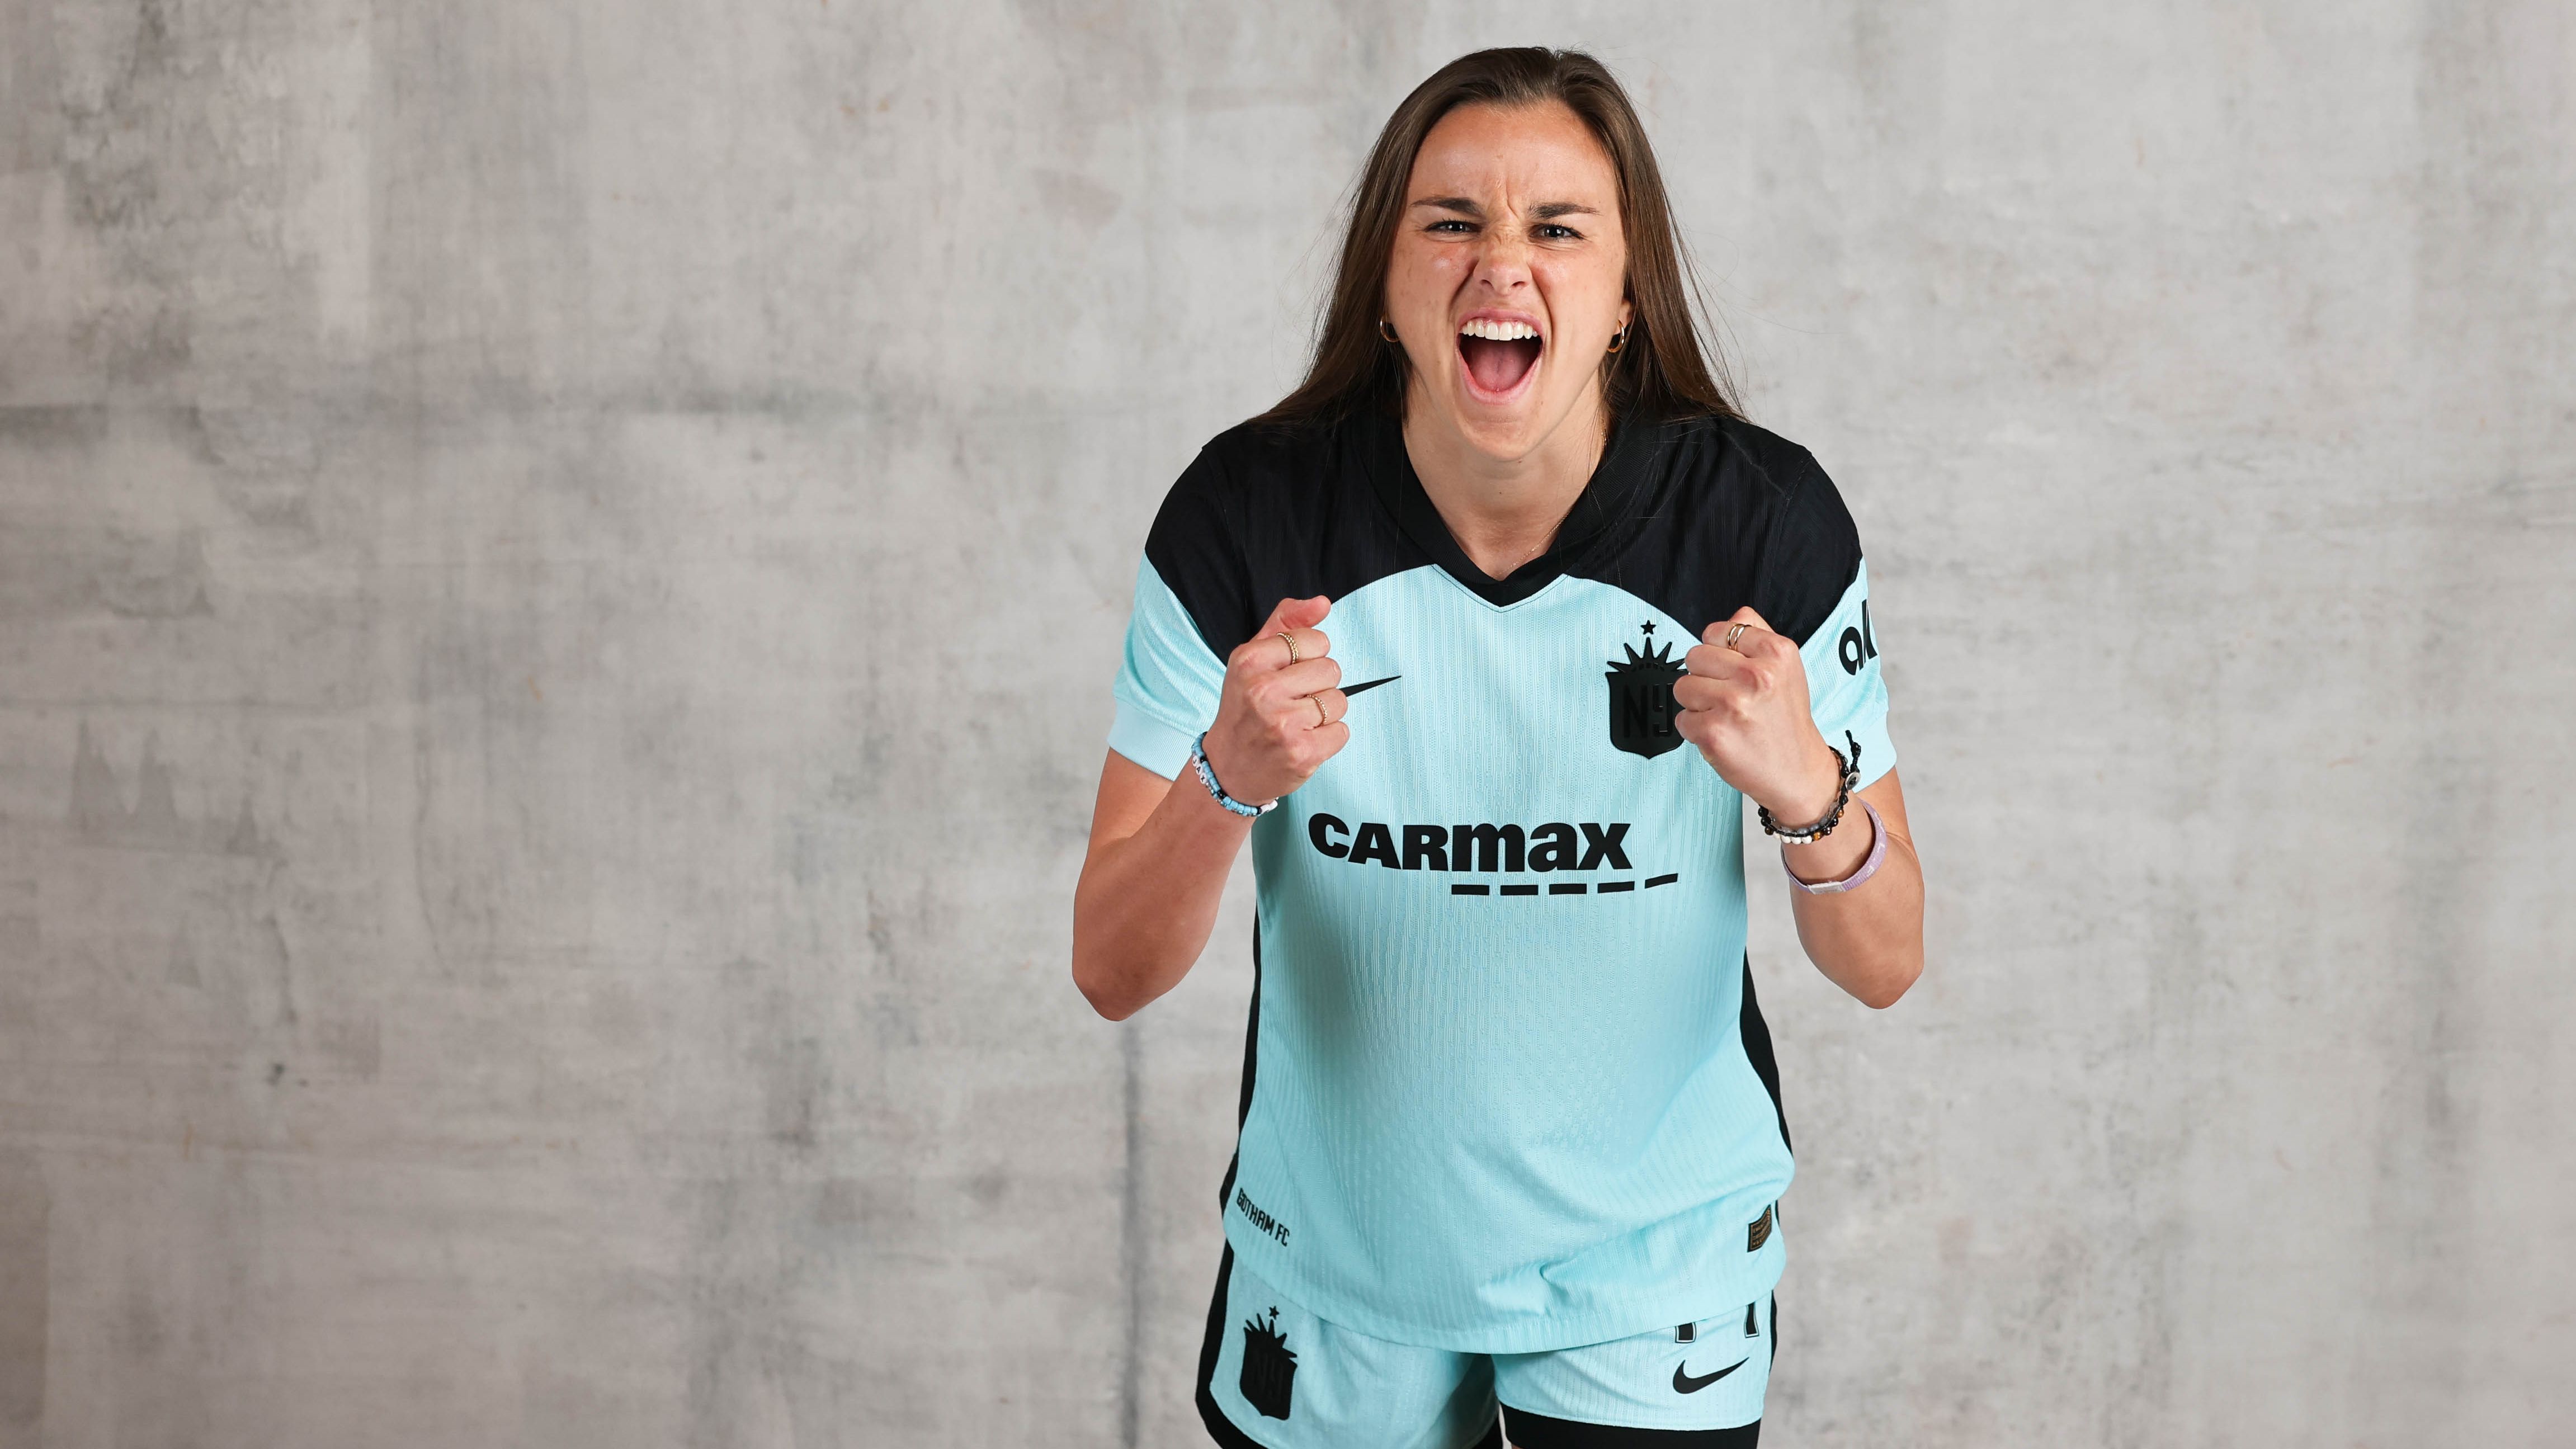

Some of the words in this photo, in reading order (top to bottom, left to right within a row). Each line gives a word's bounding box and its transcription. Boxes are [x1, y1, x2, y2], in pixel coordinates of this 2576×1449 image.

[1308, 813, 1633, 872] CARmax
[1237, 1187, 1275, 1236] GOTHAM
[1275, 1223, 1290, 1247] FC
